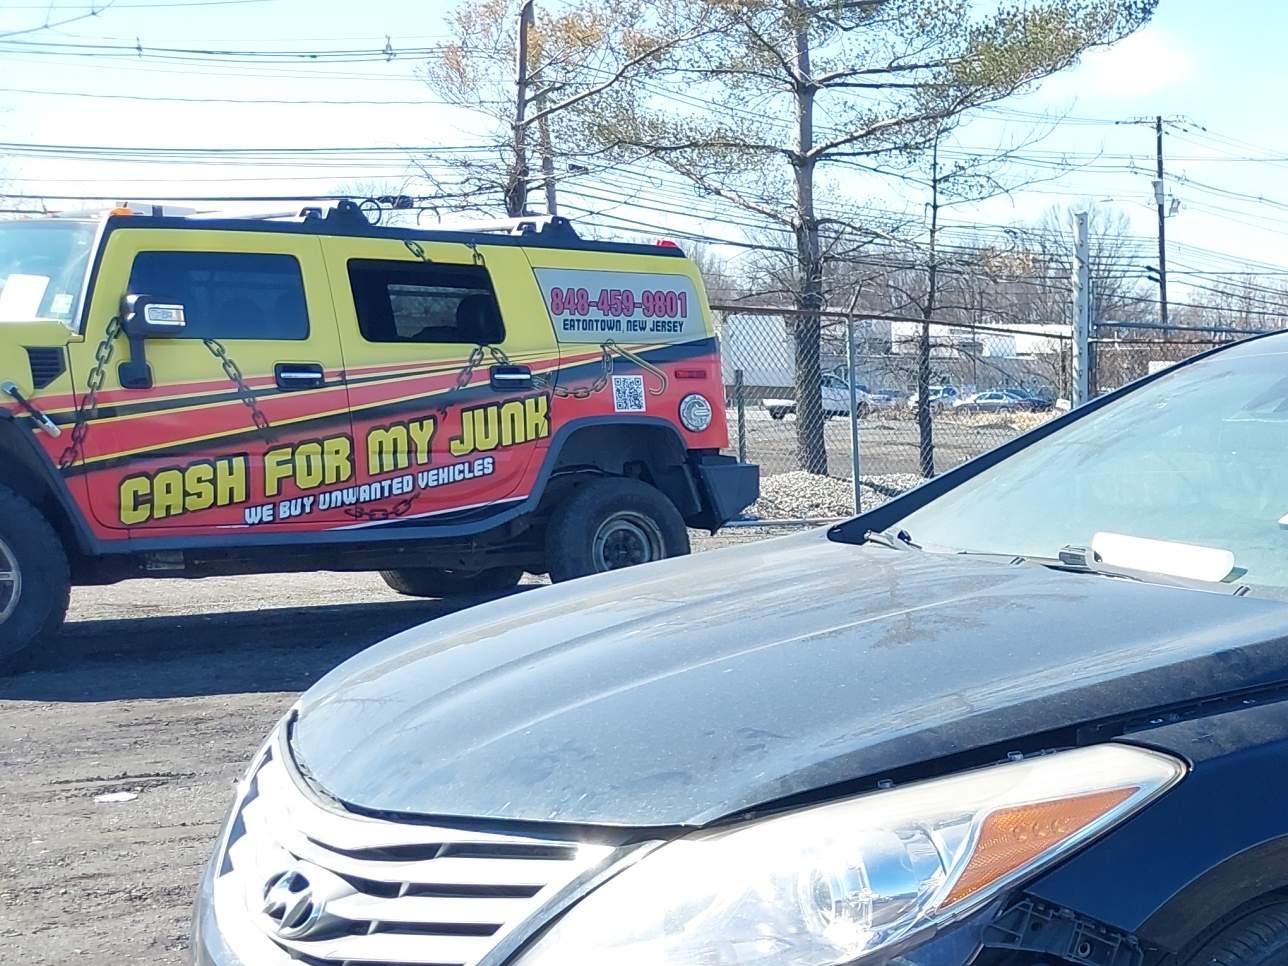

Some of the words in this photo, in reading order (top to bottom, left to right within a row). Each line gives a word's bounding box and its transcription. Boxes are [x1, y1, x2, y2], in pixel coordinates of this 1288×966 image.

[551, 287, 687, 318] 848-459-9801
[563, 319, 624, 333] EATONTOWN,
[626, 319, 647, 332] NEW
[650, 320, 684, 333] JERSEY
[119, 455, 247, 525] CASH
[264, 436, 352, 497] FOR
[367, 419, 435, 475] MY
[450, 395, 550, 457] JUNK
[244, 505, 274, 524] WE
[279, 495, 314, 519] BUY
[318, 474, 413, 510] UNWANTED
[417, 456, 494, 489] VEHICLES
